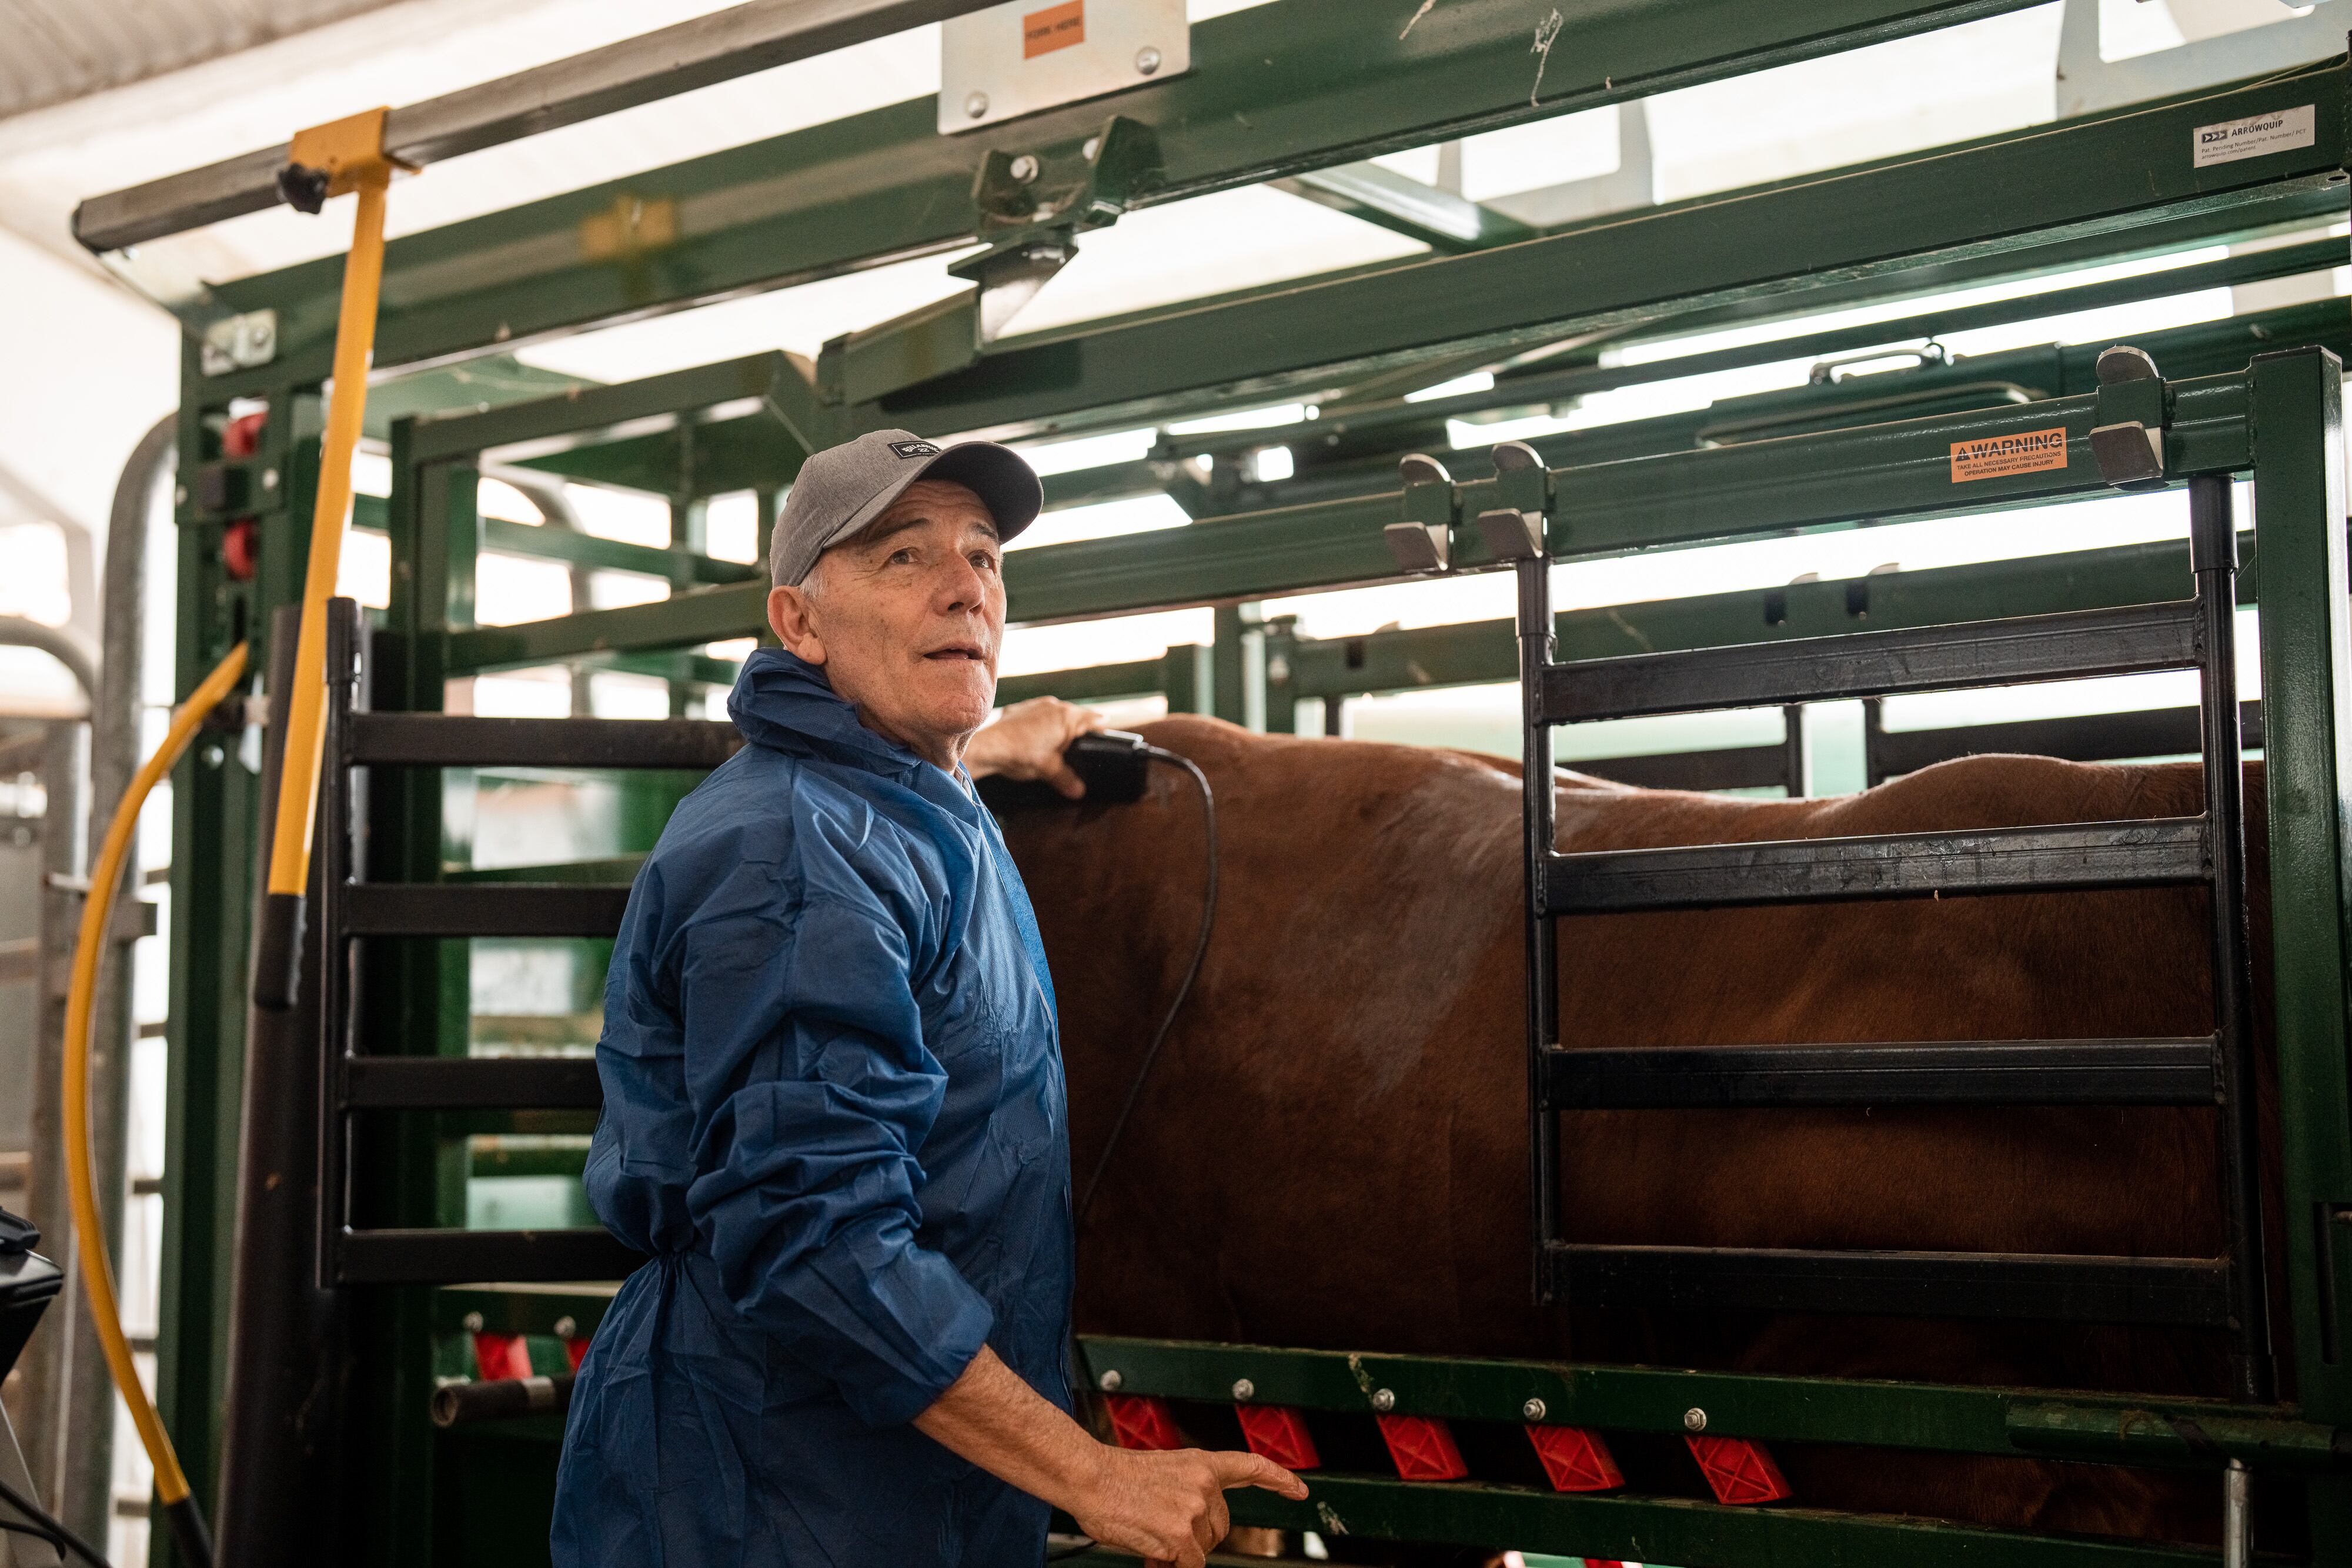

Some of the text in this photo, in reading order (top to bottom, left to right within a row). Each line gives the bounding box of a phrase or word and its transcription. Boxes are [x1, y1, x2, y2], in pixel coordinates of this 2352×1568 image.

[2231, 120, 2283, 136] ARROWQUIP
[2213, 143, 2234, 151] Pending
[2235, 137, 2268, 147] Number/Pat.
[2270, 131, 2294, 141] Number/
[2201, 145, 2256, 159] arrowquip.com/patent
[1971, 433, 2063, 459] WARNING
[1984, 457, 2018, 467] NECESSARY
[2020, 451, 2061, 462] PRECAUTIONS
